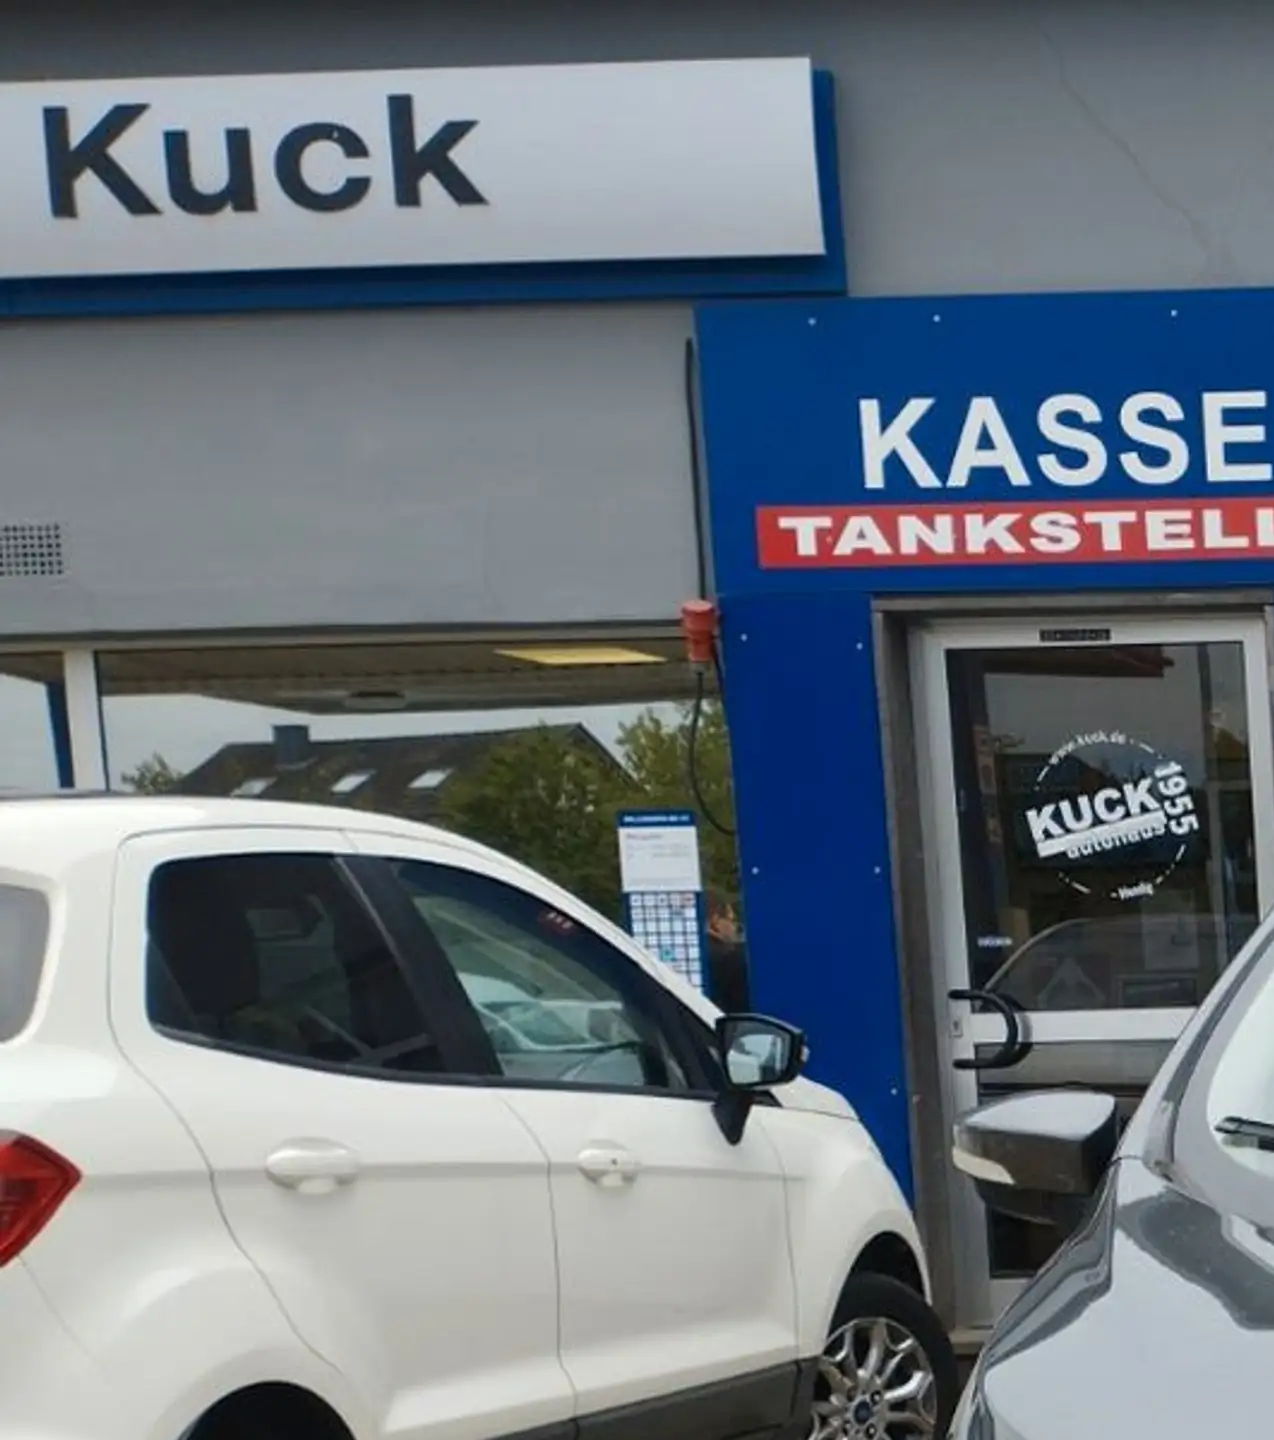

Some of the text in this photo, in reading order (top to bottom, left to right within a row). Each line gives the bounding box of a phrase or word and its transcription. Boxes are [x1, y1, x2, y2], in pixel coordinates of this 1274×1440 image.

[43, 94, 489, 219] Kuck
[859, 391, 1273, 489] KASSE
[1026, 778, 1160, 843] KUCK
[1154, 761, 1199, 834] 1955
